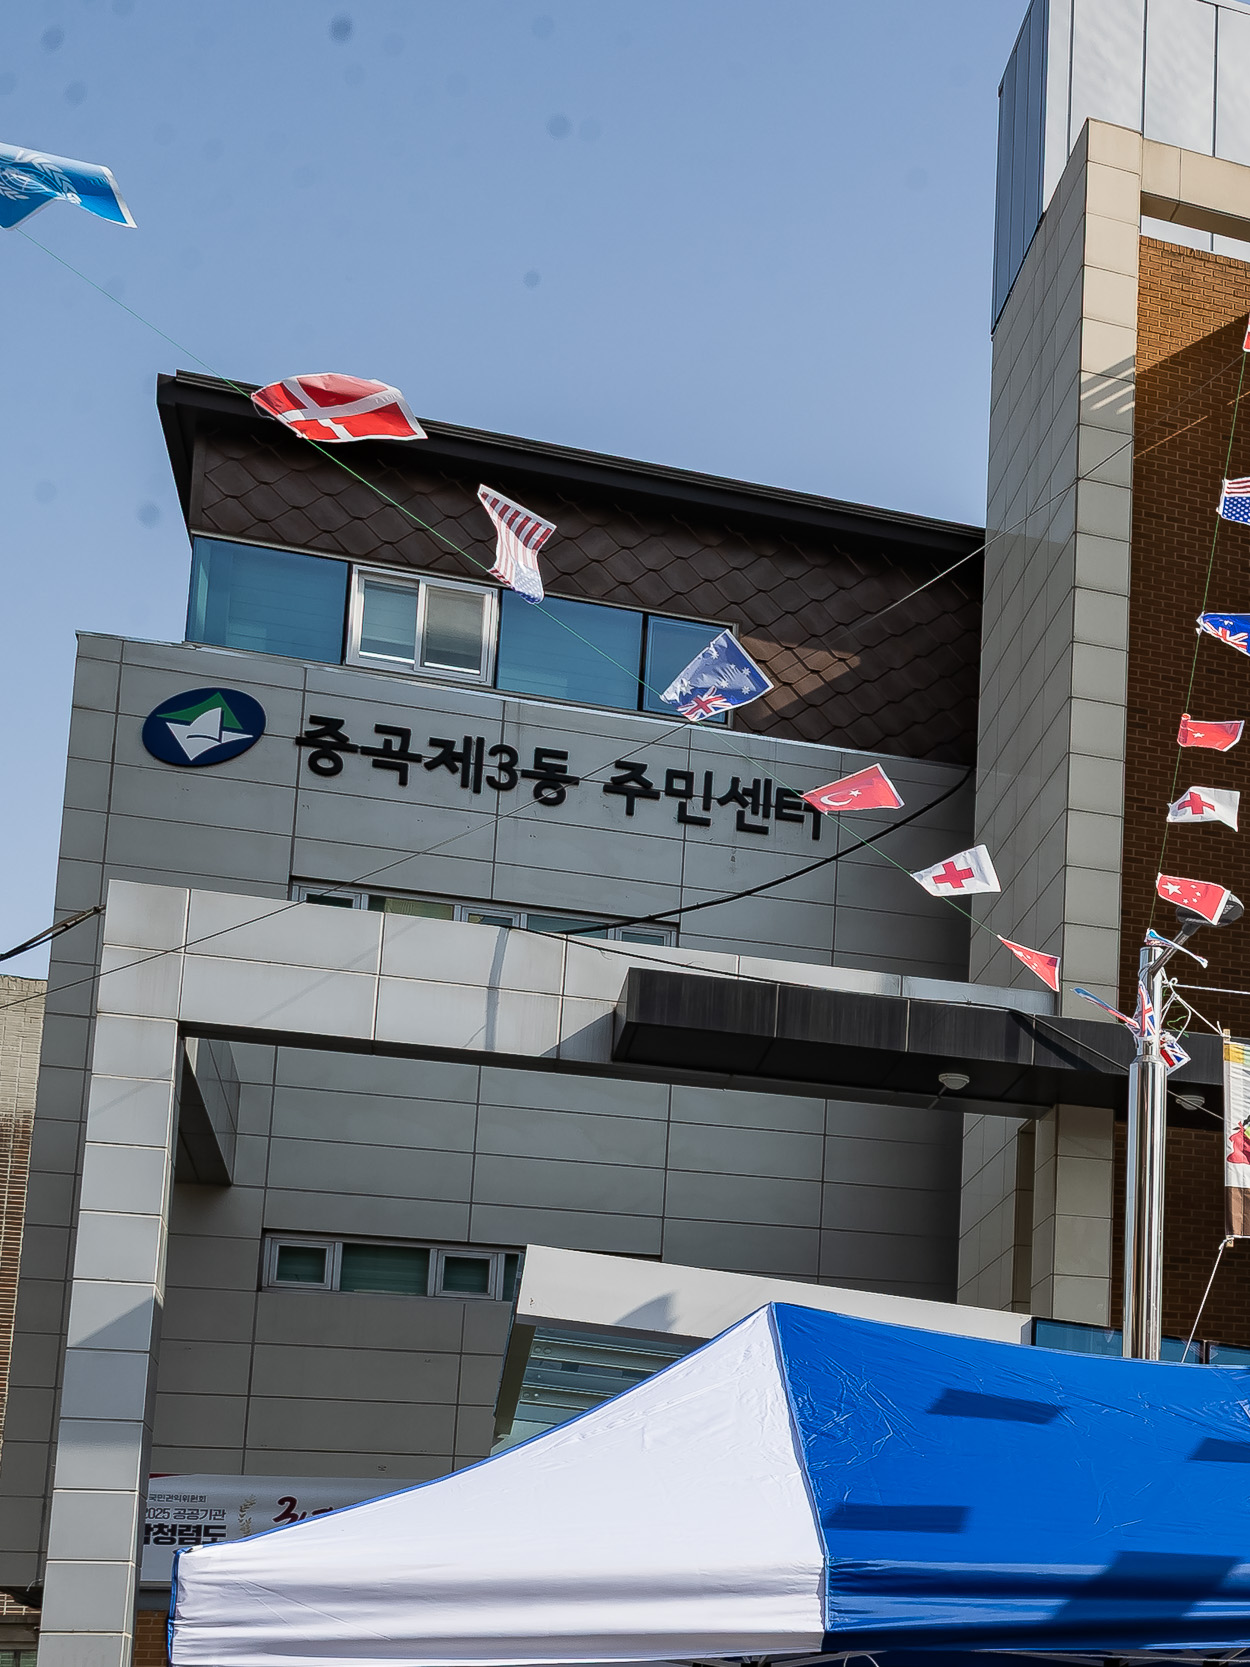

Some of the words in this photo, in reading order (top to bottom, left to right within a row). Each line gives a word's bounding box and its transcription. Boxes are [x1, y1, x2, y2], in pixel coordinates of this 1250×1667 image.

[295, 715, 581, 806] 중곡제3동
[603, 759, 823, 840] 주민센터
[173, 1507, 227, 1521] 공공기관
